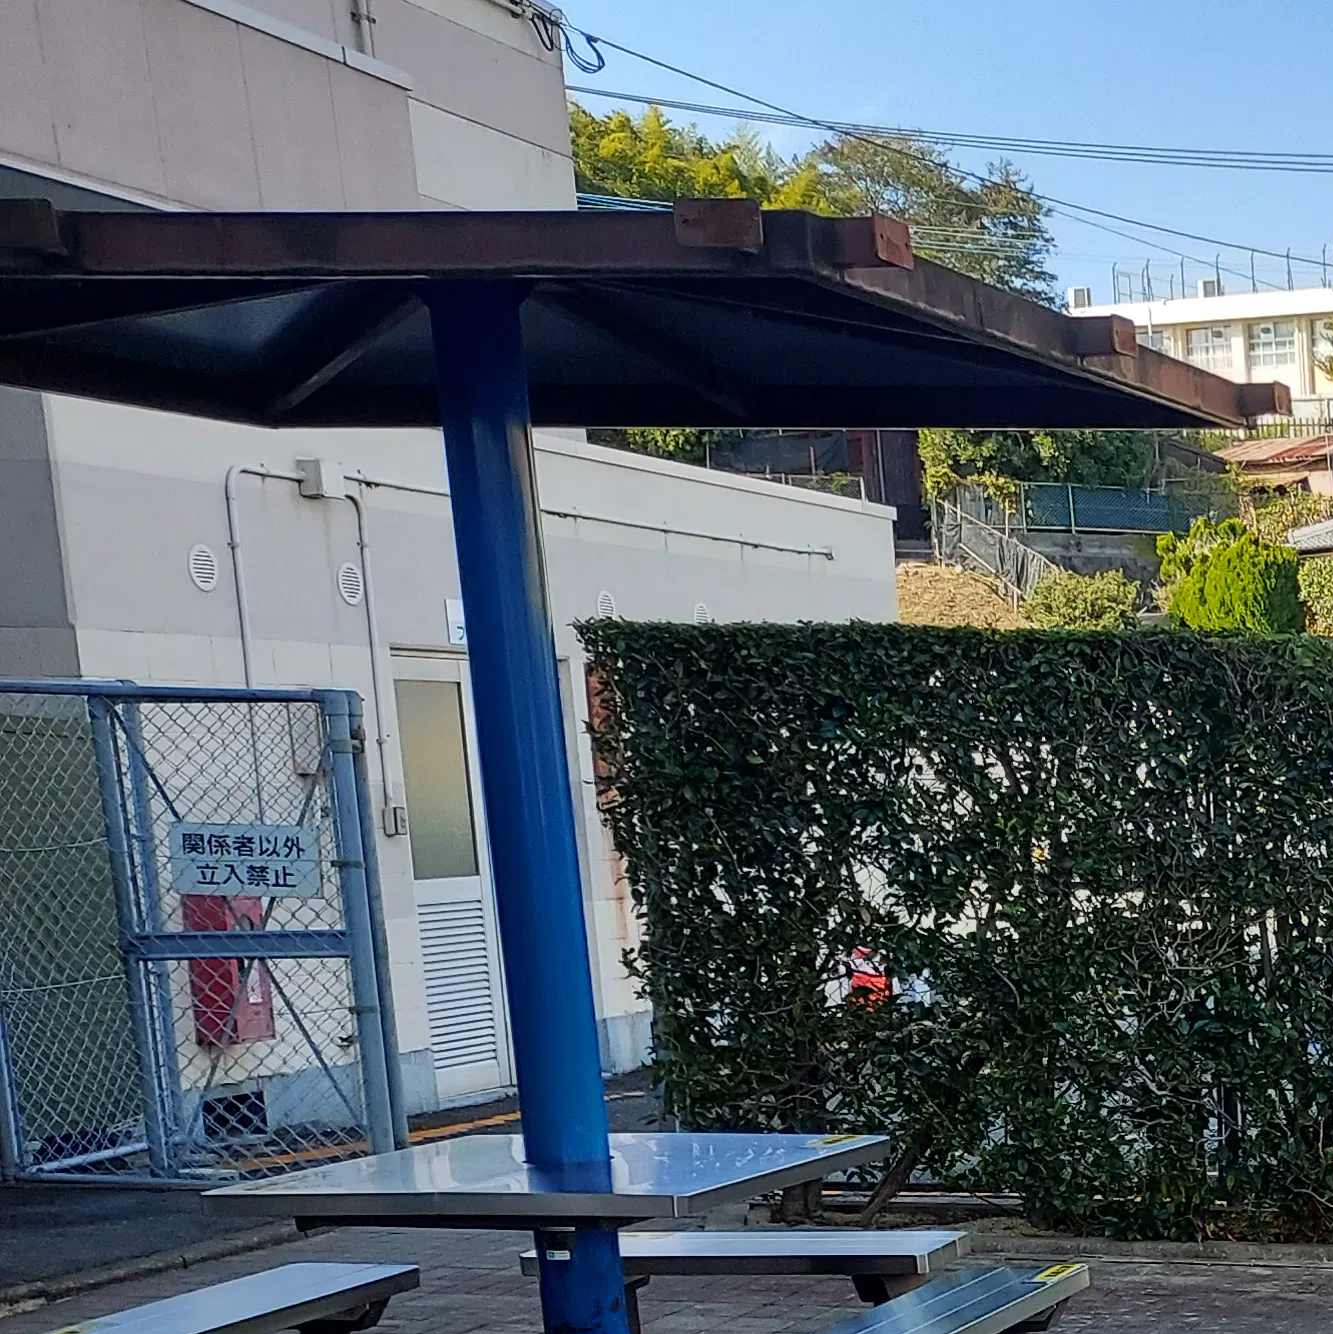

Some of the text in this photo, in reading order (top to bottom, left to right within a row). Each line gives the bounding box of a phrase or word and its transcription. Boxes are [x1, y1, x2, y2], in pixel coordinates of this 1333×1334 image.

[181, 832, 305, 859] 関係者以外
[196, 863, 297, 888] 立入禁止
